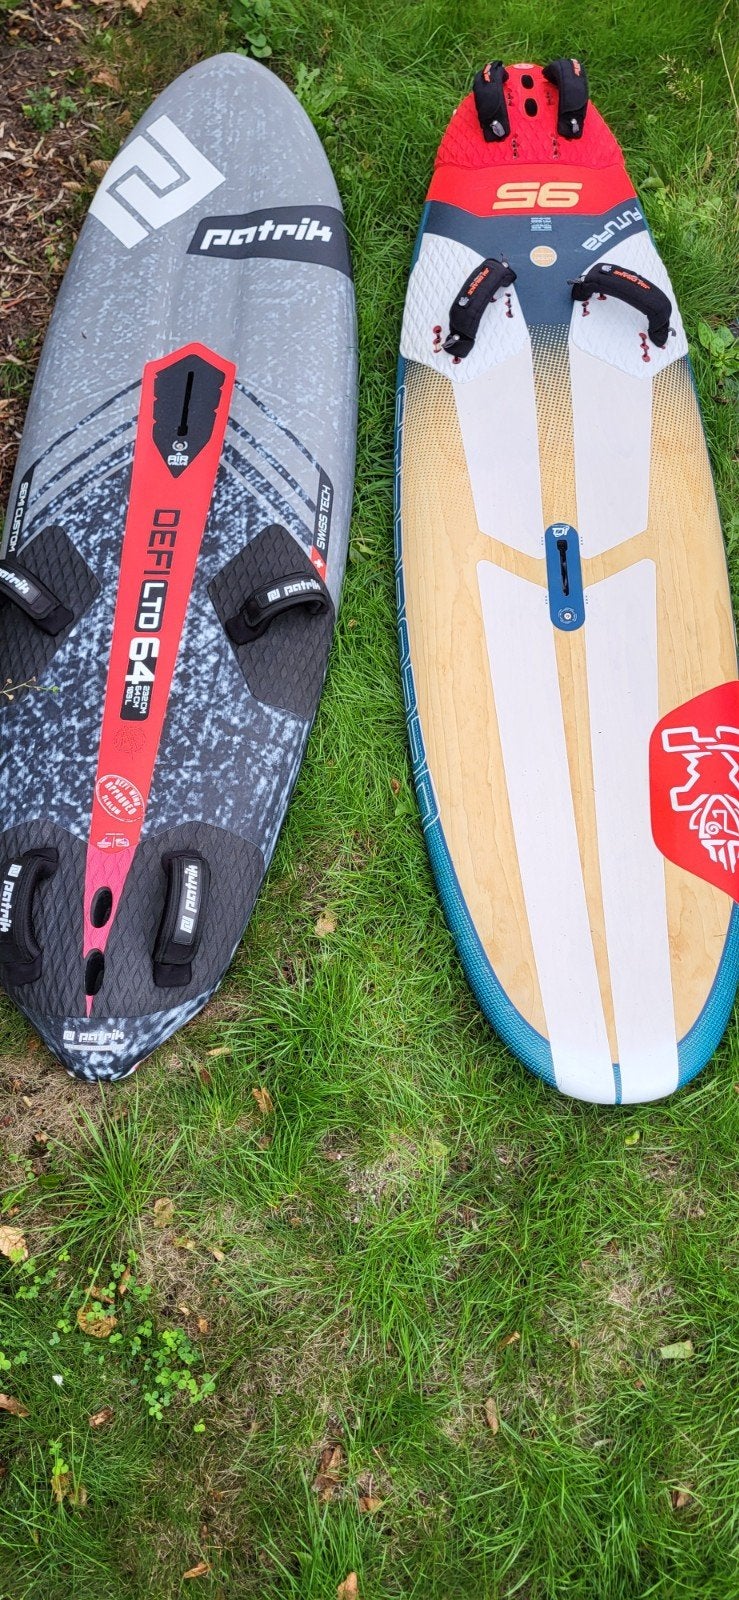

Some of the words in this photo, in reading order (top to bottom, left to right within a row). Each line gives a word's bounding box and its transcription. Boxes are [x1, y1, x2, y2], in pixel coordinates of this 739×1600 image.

[492, 181, 583, 210] 95
[200, 217, 333, 250] patrik
[581, 206, 643, 251] FUTURA
[167, 452, 189, 463] AIR
[17, 482, 29, 507] SEMI
[319, 484, 331, 513] TECH
[8, 507, 24, 553] CUSTOM
[143, 509, 181, 576] DEFI
[316, 513, 329, 550] SWISS
[0, 567, 30, 595] atrik
[283, 579, 321, 596] patrik
[125, 637, 160, 685] 64
[104, 781, 137, 815] APPROVED
[185, 864, 198, 913] patrik
[78, 1029, 125, 1043] patrik
